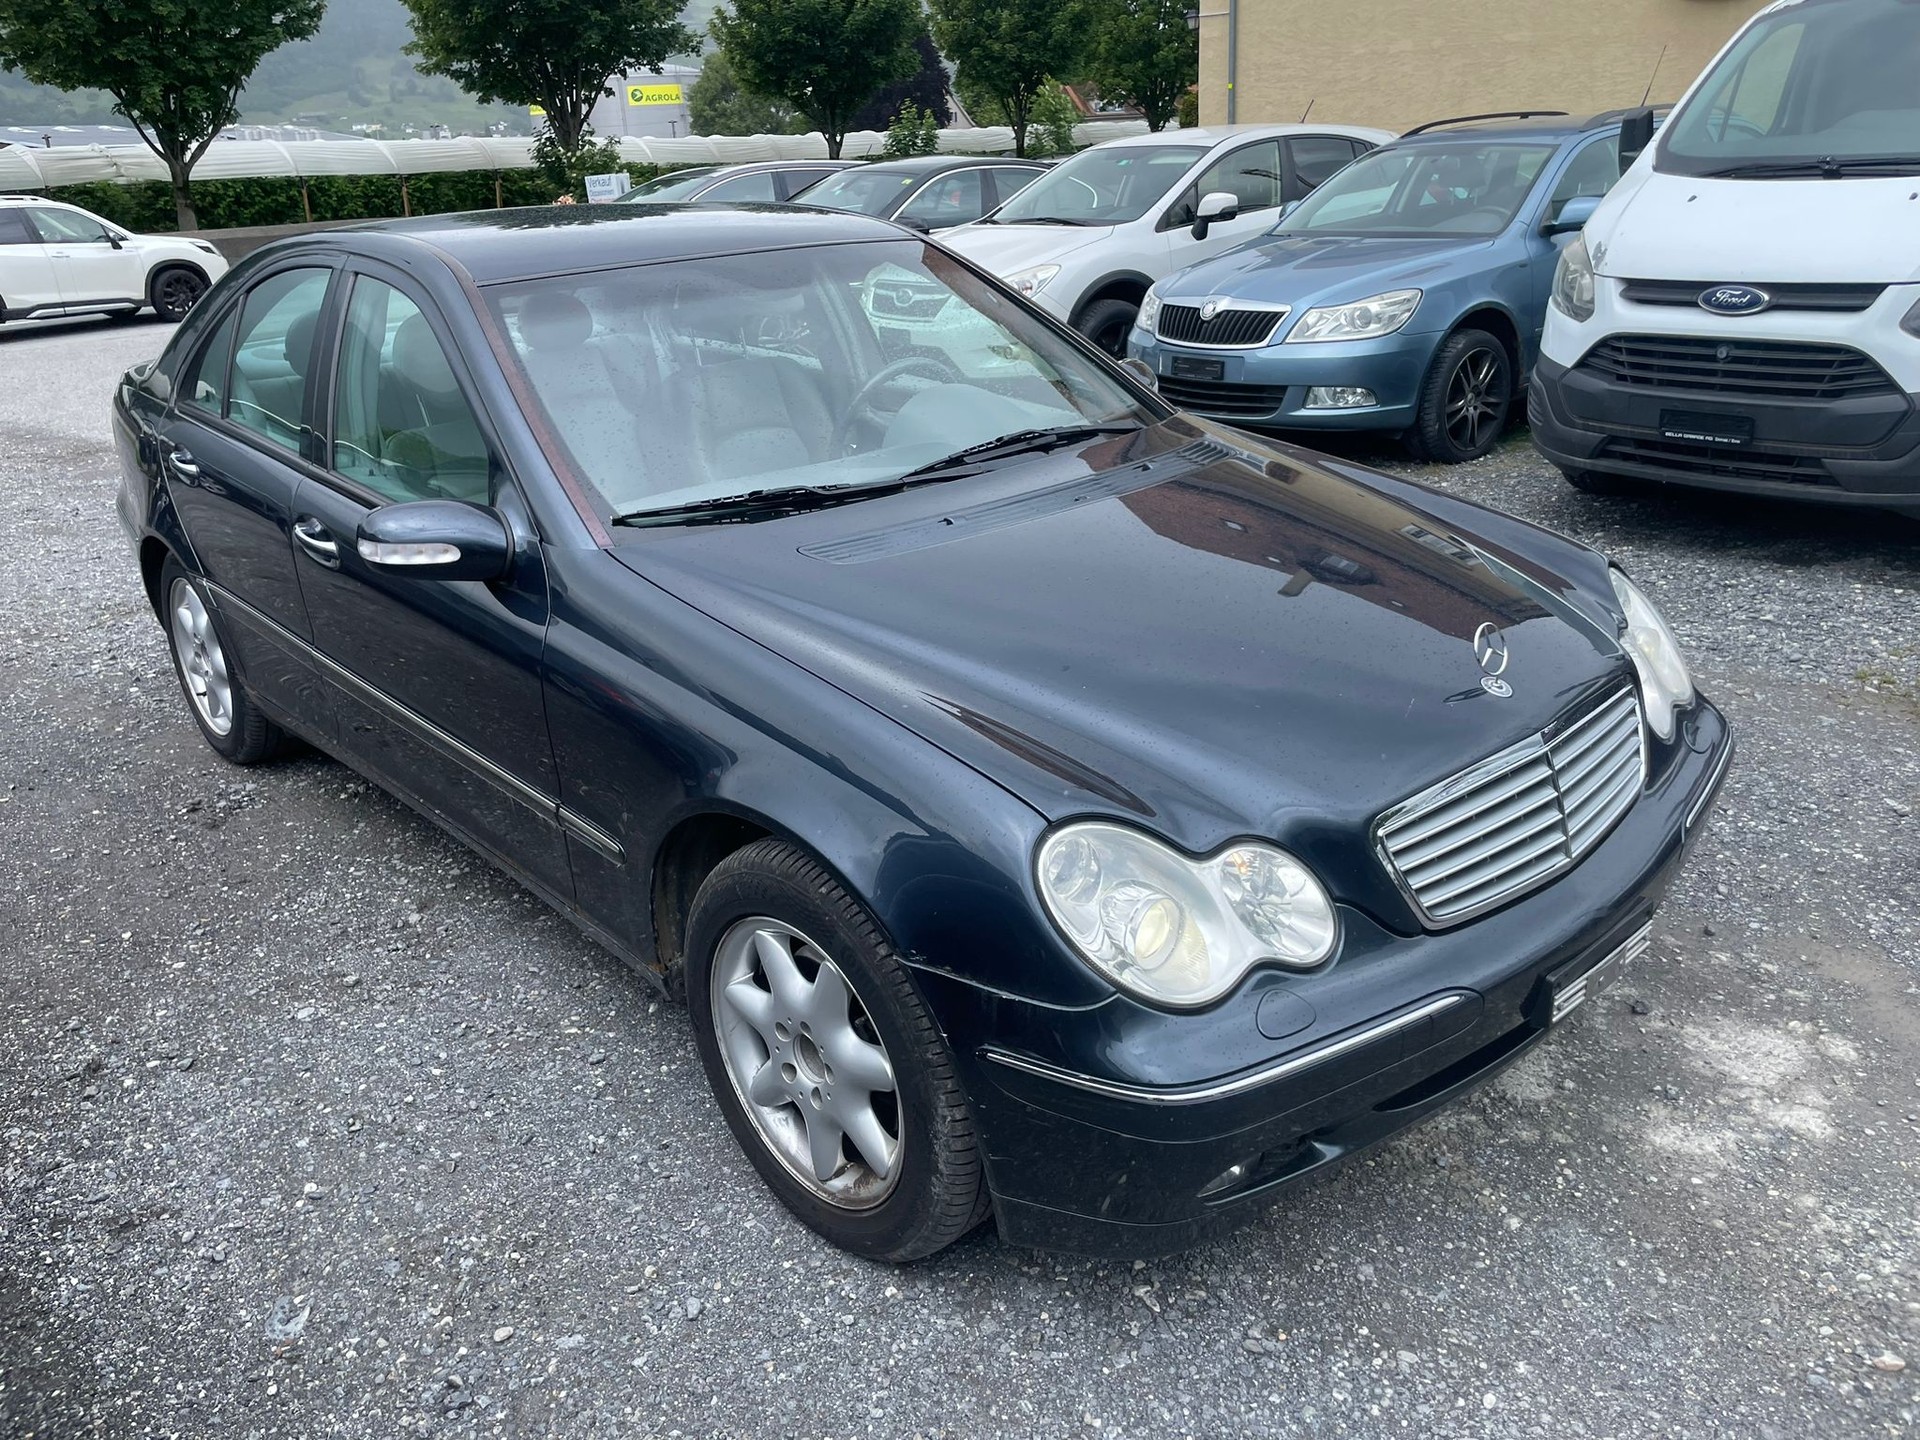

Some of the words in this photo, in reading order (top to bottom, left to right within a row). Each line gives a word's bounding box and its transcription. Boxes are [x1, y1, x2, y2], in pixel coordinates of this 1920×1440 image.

[645, 93, 681, 102] AGROLA
[587, 175, 611, 188] Verkauf
[1711, 289, 1751, 305] Ford
